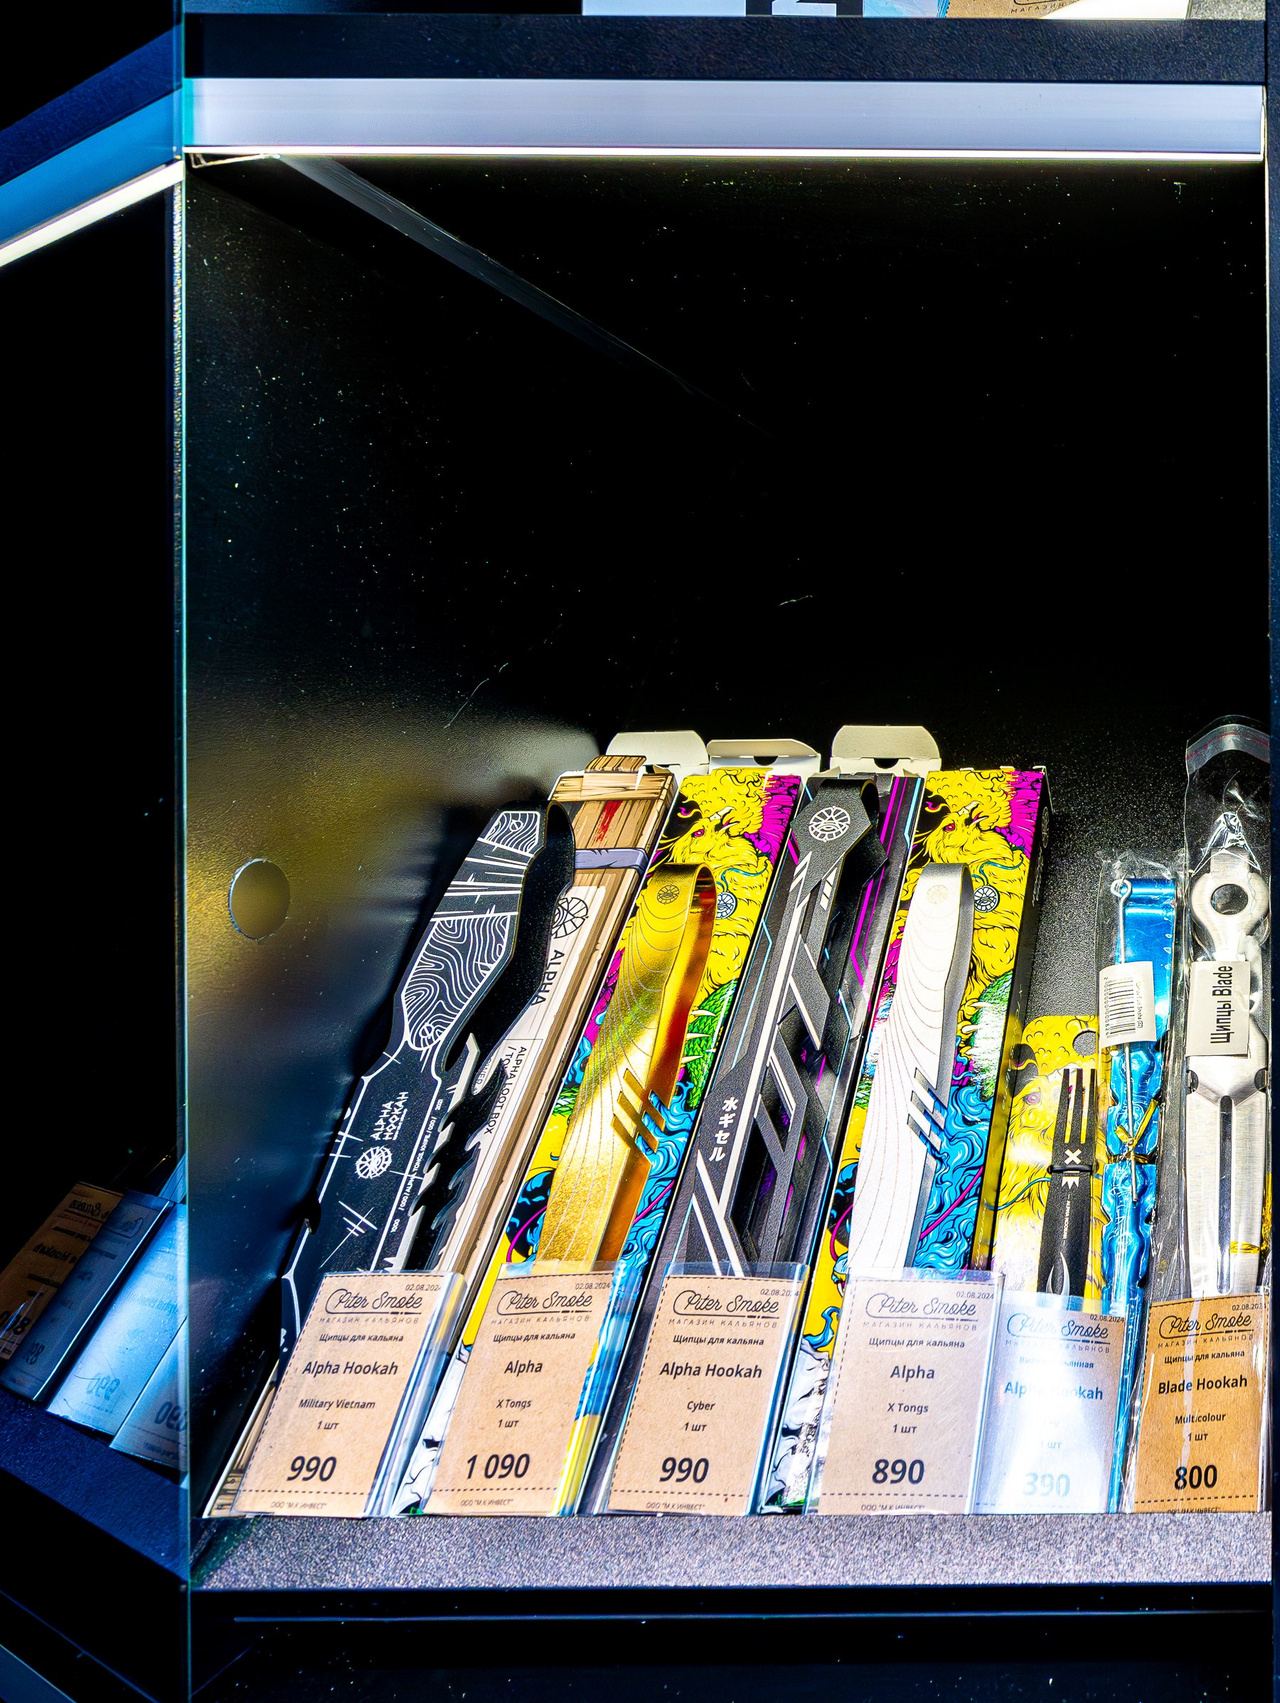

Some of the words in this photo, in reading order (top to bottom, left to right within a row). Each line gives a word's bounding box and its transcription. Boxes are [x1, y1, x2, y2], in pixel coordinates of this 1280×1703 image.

[531, 949, 565, 1006] ALPHA
[1212, 965, 1233, 997] Blade
[1210, 1000, 1235, 1044] Щипцы
[507, 1046, 527, 1079] ALPHA
[370, 1101, 395, 1140] ALPHA
[382, 1092, 409, 1140] HOOKAH
[484, 1112, 500, 1135] BOX
[709, 1097, 738, 1162] 水ギセル
[575, 1282, 610, 1290] 02.08.2024
[760, 1289, 799, 1297] 02.08.204
[372, 1292, 423, 1309] Smoke
[542, 1291, 592, 1309] Smoke
[956, 1291, 994, 1300] 02.08.2024
[726, 1295, 779, 1313] Smoke
[923, 1297, 977, 1316] Smoke
[491, 1317, 531, 1325] МАГАЗИН
[721, 1320, 778, 1329] КАЛЬЯНОВ
[919, 1322, 977, 1331] КАЛЬЯНОВ
[1089, 1314, 1125, 1323] 02.08.2024
[1205, 1312, 1251, 1331] Smoke
[1061, 1319, 1109, 1339] Smoke
[319, 1333, 349, 1343] Щипцы
[350, 1334, 366, 1343] для
[367, 1334, 404, 1342] кальяна
[493, 1334, 522, 1343] Щипцы
[523, 1334, 539, 1342] для
[540, 1332, 575, 1340] кальяна
[673, 1335, 706, 1344] Щипцы
[707, 1336, 724, 1345] для
[726, 1337, 764, 1346] кальяна
[869, 1337, 904, 1347] Щипцы
[906, 1338, 924, 1348] для
[926, 1340, 965, 1349] кальяна
[1158, 1338, 1198, 1349] МАГАЗИН
[1164, 1354, 1194, 1364] Щипцы
[1195, 1352, 1210, 1362] для
[1211, 1350, 1245, 1360] кальяна
[302, 1361, 340, 1377] Alpha
[343, 1361, 398, 1375] Hookah
[504, 1361, 543, 1377] Alpha
[659, 1362, 701, 1380] Alpha
[705, 1364, 762, 1378] Hookah
[890, 1365, 935, 1382] Alpha
[1158, 1379, 1193, 1395] Blade
[1196, 1375, 1248, 1391] Hookah
[298, 1399, 334, 1410] Military
[335, 1400, 375, 1409] Vietnam
[496, 1400, 503, 1408] X
[505, 1399, 531, 1409] Tongs
[687, 1401, 715, 1412] Cyber
[887, 1403, 894, 1412] X
[898, 1403, 929, 1415] Tongs
[317, 1421, 322, 1430] 1
[323, 1422, 339, 1430] шт
[498, 1420, 502, 1428] 1
[504, 1420, 519, 1428] шт
[684, 1422, 689, 1431] 1
[691, 1423, 707, 1431] шт
[1175, 1413, 1226, 1425] Multicolour
[893, 1424, 898, 1433] 1
[900, 1425, 917, 1434] шт
[1188, 1433, 1192, 1442] 1
[1194, 1432, 1208, 1441] шт
[286, 1456, 337, 1481] 990
[466, 1454, 478, 1479] 1
[484, 1453, 530, 1479] 090
[659, 1457, 709, 1483] 990
[872, 1459, 925, 1485] 890
[1023, 1472, 1071, 1497] 390
[1174, 1464, 1218, 1490] 800
